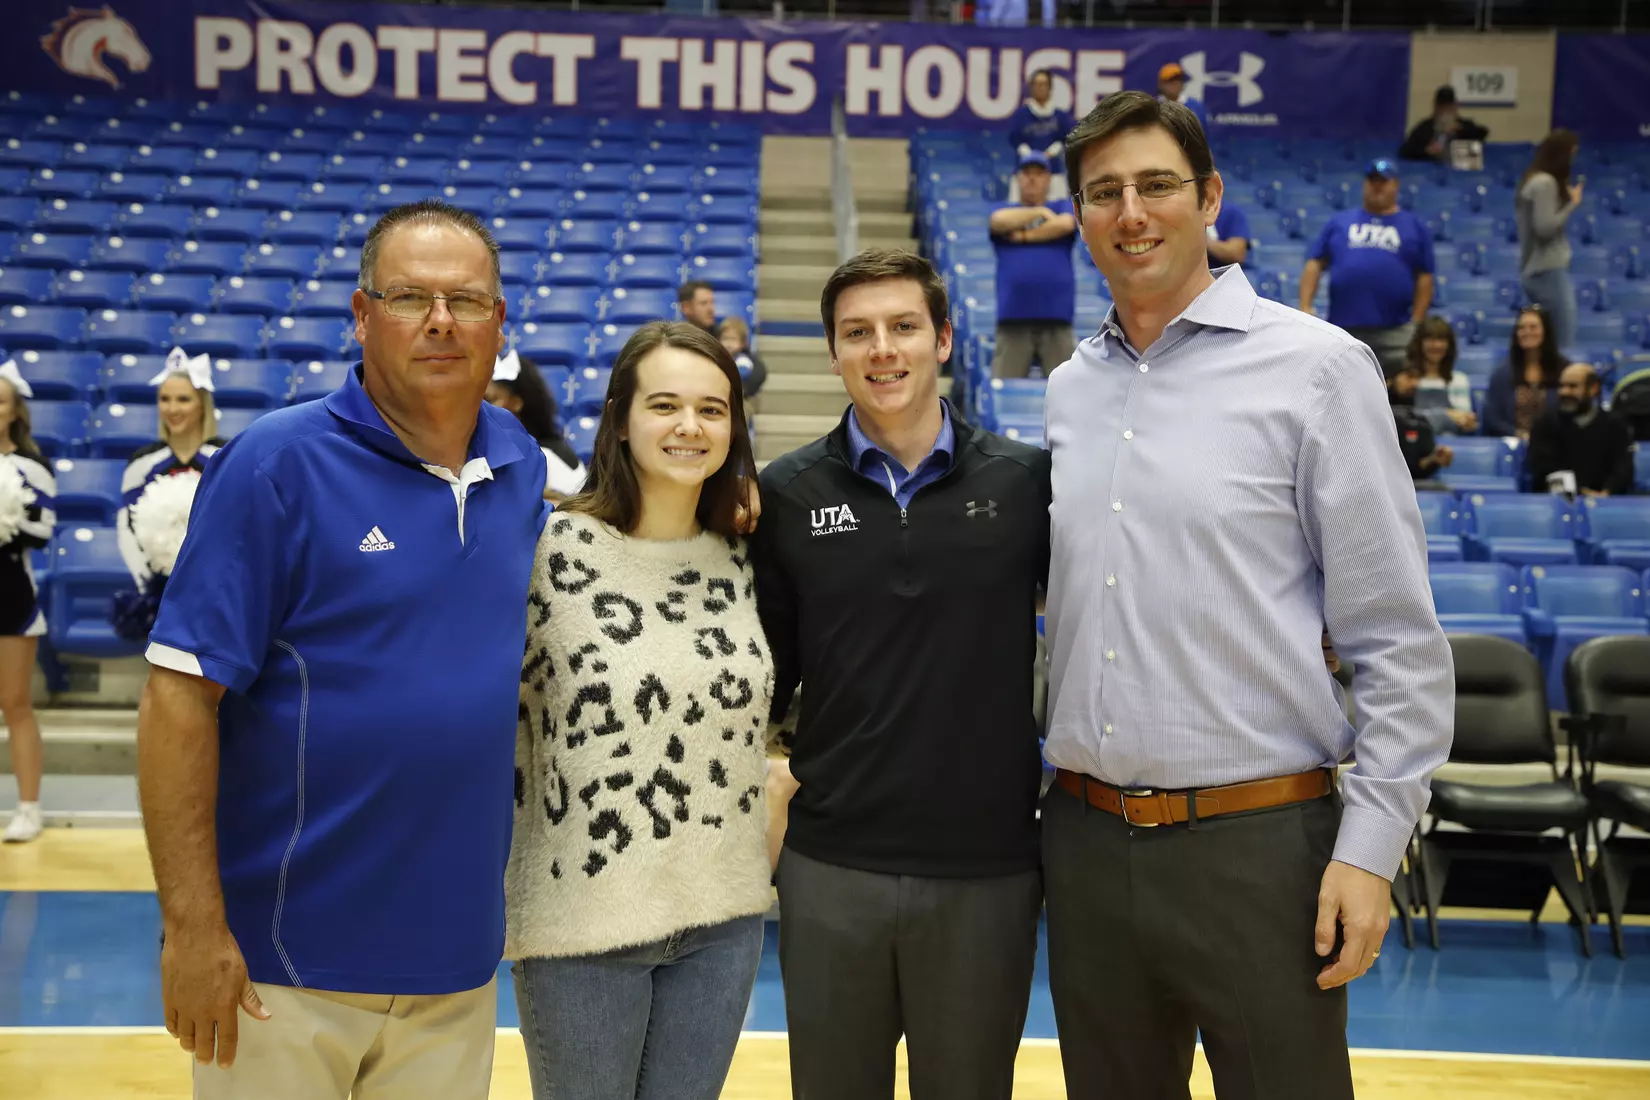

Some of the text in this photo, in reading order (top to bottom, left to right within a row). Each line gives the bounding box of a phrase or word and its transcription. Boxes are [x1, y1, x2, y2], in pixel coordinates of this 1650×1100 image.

[195, 16, 1126, 119] PROTECT THIS HOUSE
[1465, 72, 1505, 95] 109
[1348, 223, 1401, 248] UTA
[811, 504, 856, 528] UTA
[811, 524, 858, 537] VOLLEYBALL
[358, 541, 395, 552] adidas
